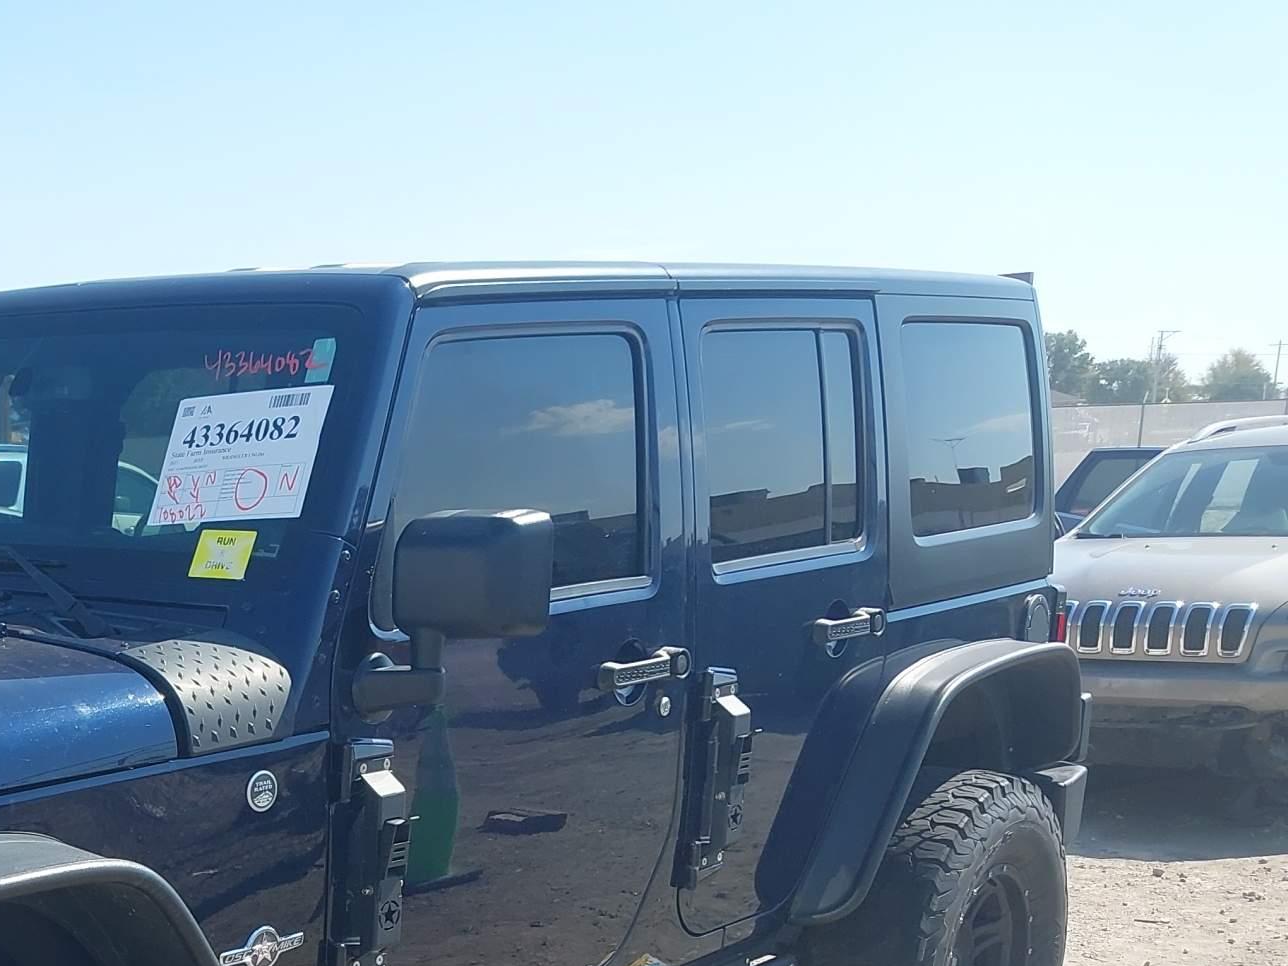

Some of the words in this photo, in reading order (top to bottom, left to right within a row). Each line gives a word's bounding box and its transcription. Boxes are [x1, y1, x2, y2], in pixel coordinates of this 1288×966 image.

[205, 349, 327, 380] 43364082
[182, 416, 300, 448] 43364082
[203, 447, 232, 455] Insurance
[280, 466, 299, 491] N
[216, 536, 237, 546] RUN
[272, 936, 302, 952] MIKE
